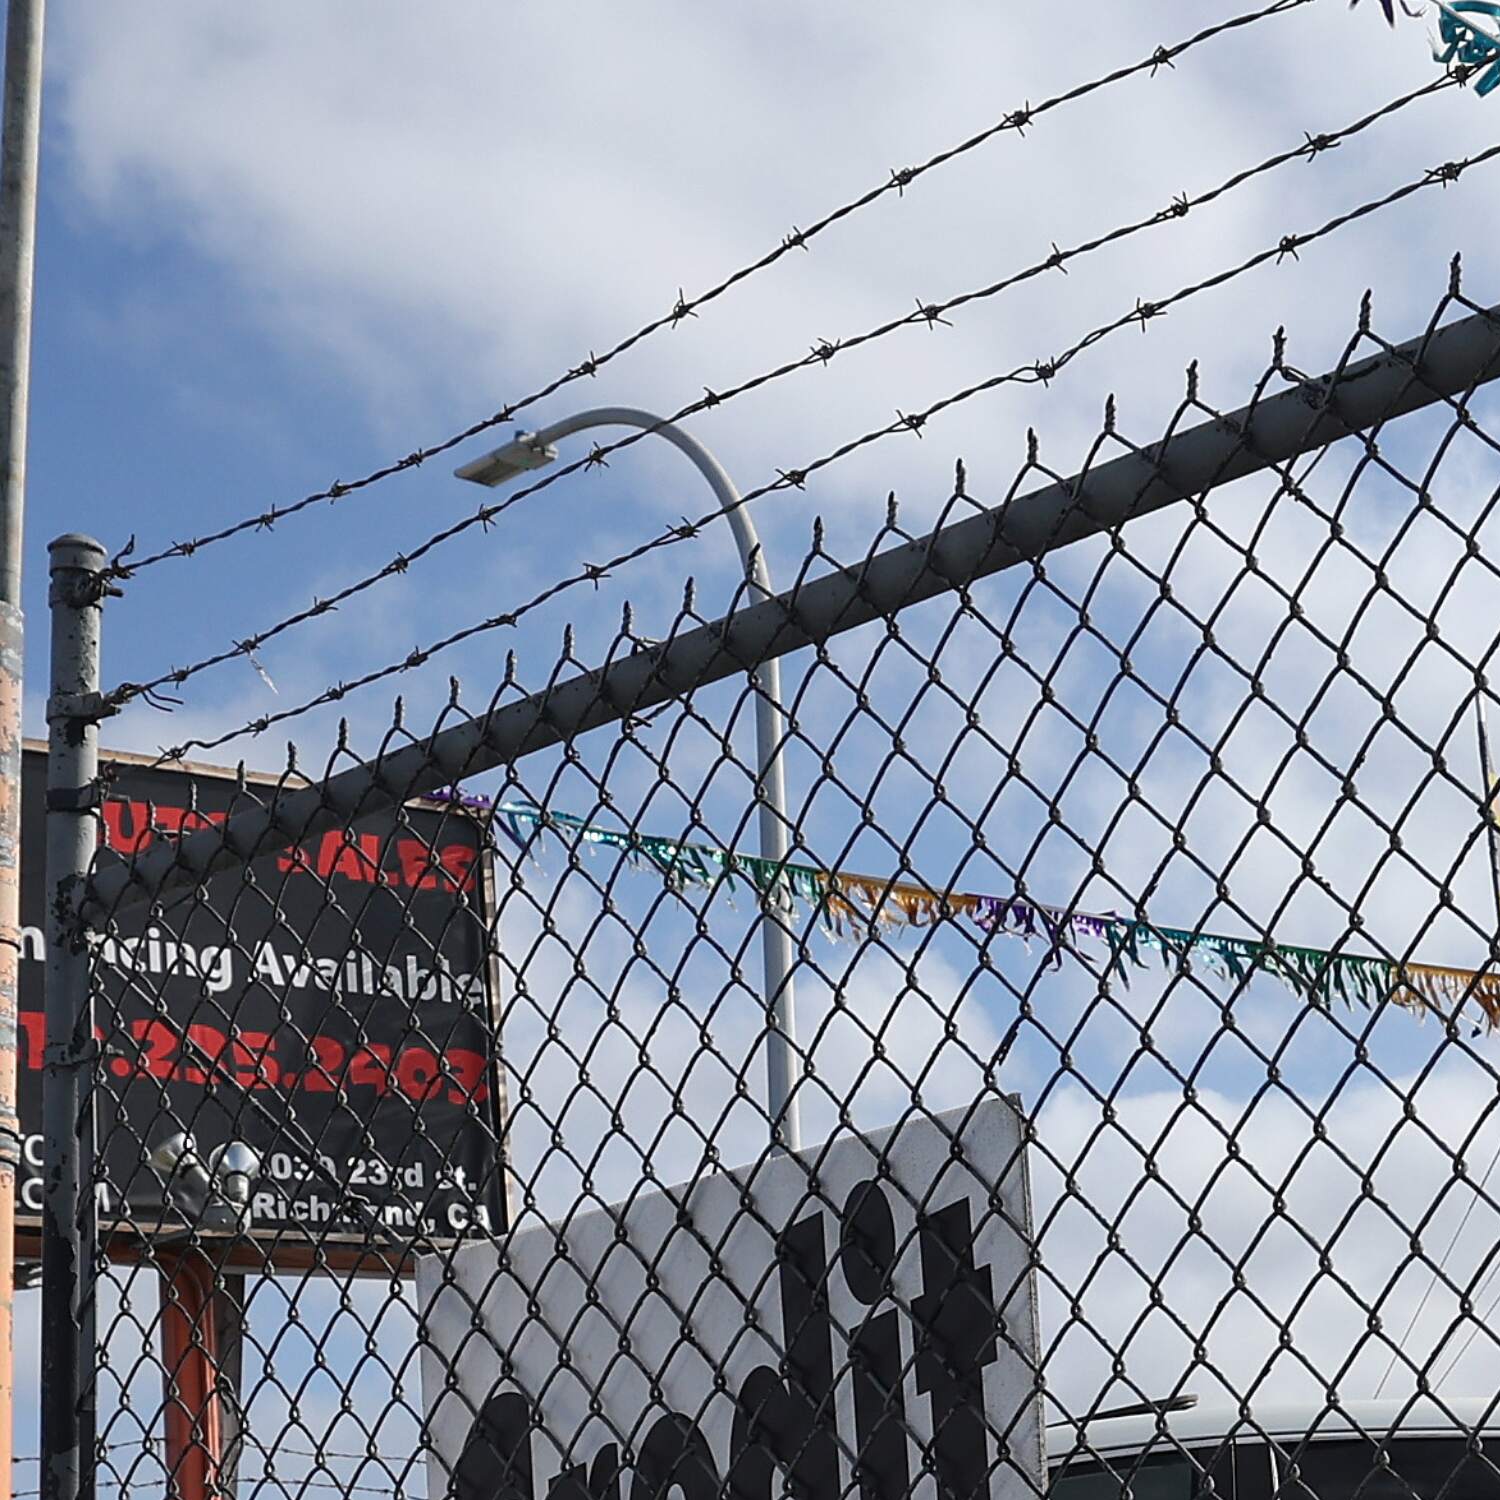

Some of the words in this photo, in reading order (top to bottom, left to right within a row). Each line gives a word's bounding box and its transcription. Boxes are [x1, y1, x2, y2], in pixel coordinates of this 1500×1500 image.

[248, 940, 485, 1004] Available
[252, 1191, 437, 1232] Richnd,
[447, 1203, 493, 1231] CA
